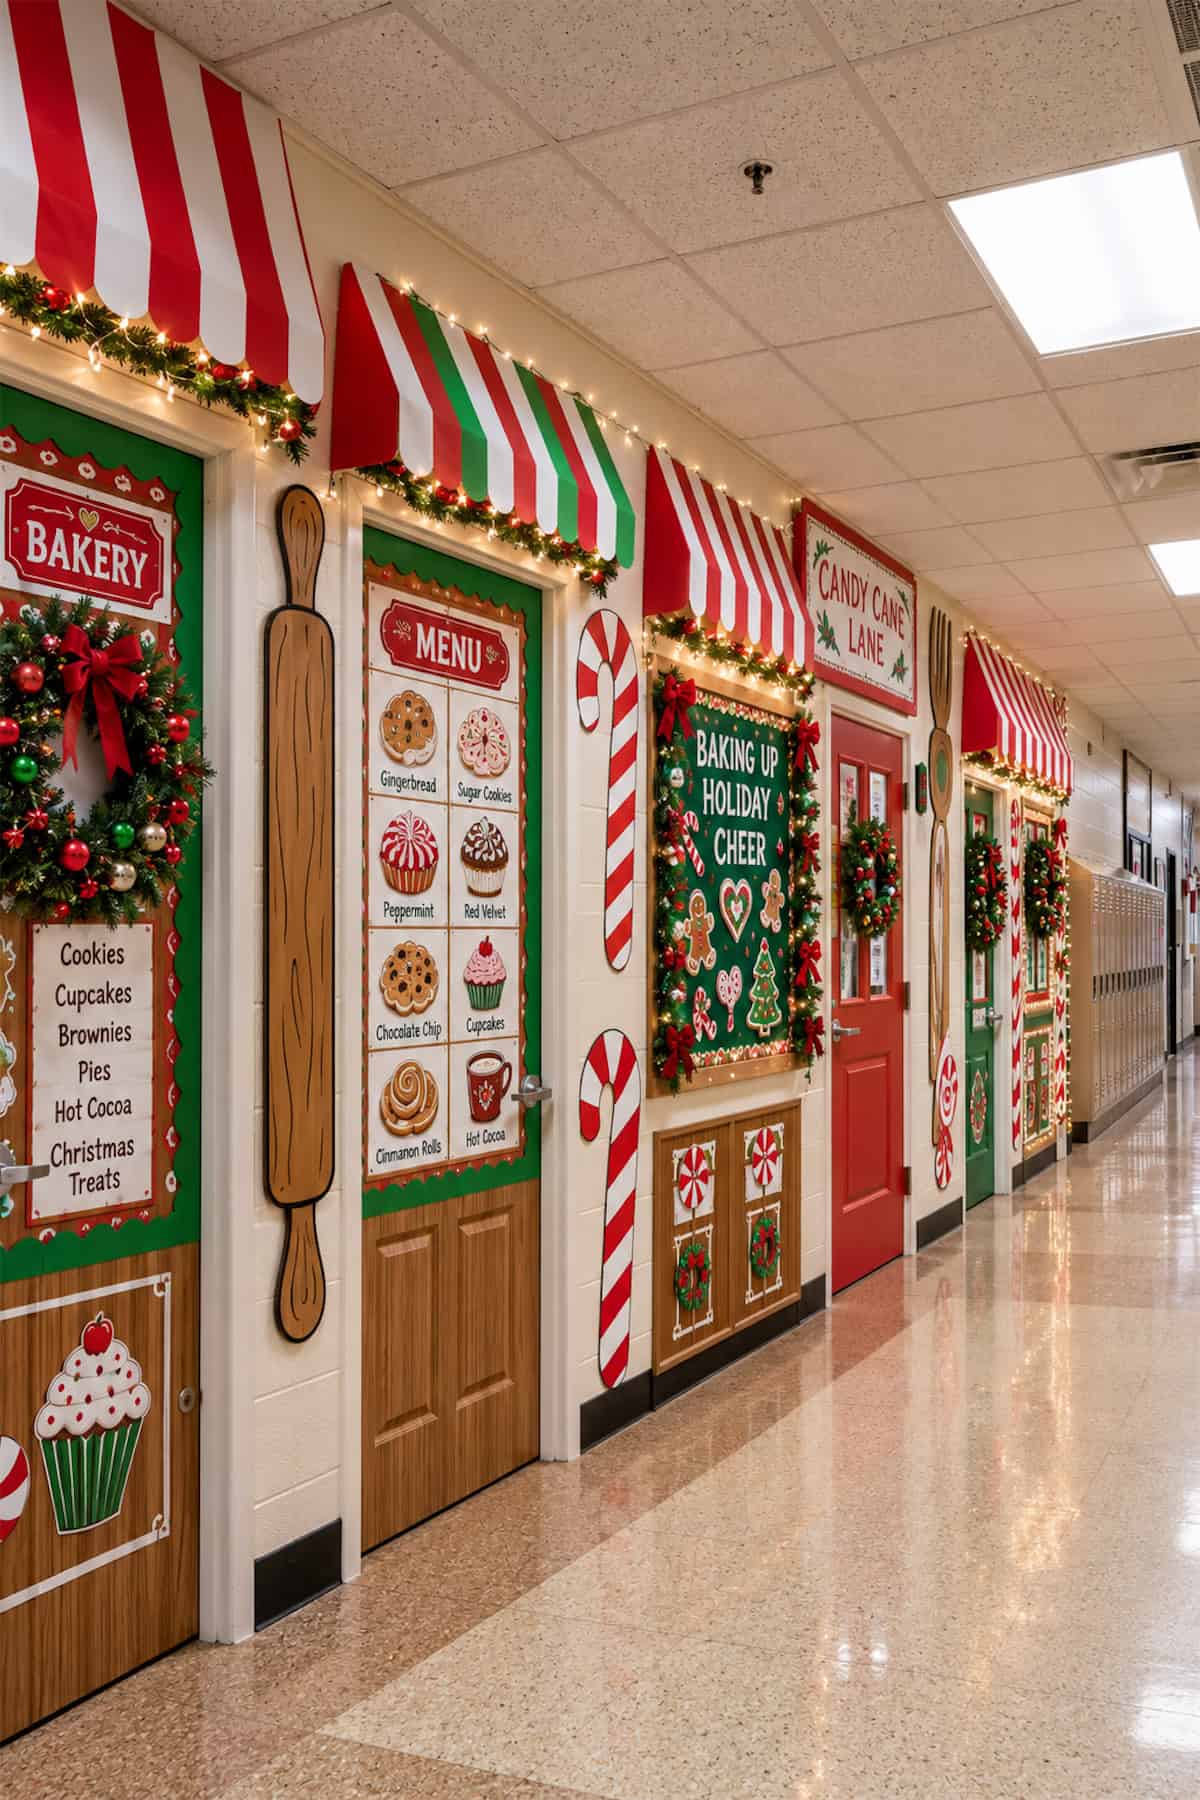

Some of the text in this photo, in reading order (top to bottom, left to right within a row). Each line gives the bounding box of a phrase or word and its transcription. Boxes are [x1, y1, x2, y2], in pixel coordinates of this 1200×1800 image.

[27, 519, 148, 589] BAKERY
[818, 559, 904, 640] CANDY CANE
[415, 623, 482, 673] MENU
[848, 617, 884, 667] LANE
[696, 729, 779, 778] BAKING UP
[380, 770, 437, 793] Gingerbread
[457, 782, 512, 803] Sugar Cookies
[702, 777, 771, 821] HOLIDAY
[713, 827, 767, 867] CHEER
[383, 901, 434, 923] Peppermint
[464, 903, 506, 919] Red Velvet
[60, 941, 125, 966] Cookies
[55, 980, 132, 1013] Cupcakes
[58, 1023, 132, 1047] Brownies
[376, 1021, 442, 1041] Chocolate Chip
[466, 1016, 505, 1036] Cupcakes
[78, 1061, 111, 1083] Pies
[55, 1097, 132, 1123] Hot Cocoa
[422, 1139, 442, 1155] Rolls
[466, 1129, 506, 1147] Hot Cocoa
[50, 1138, 135, 1168] Christmas
[68, 1169, 121, 1196] Treats
